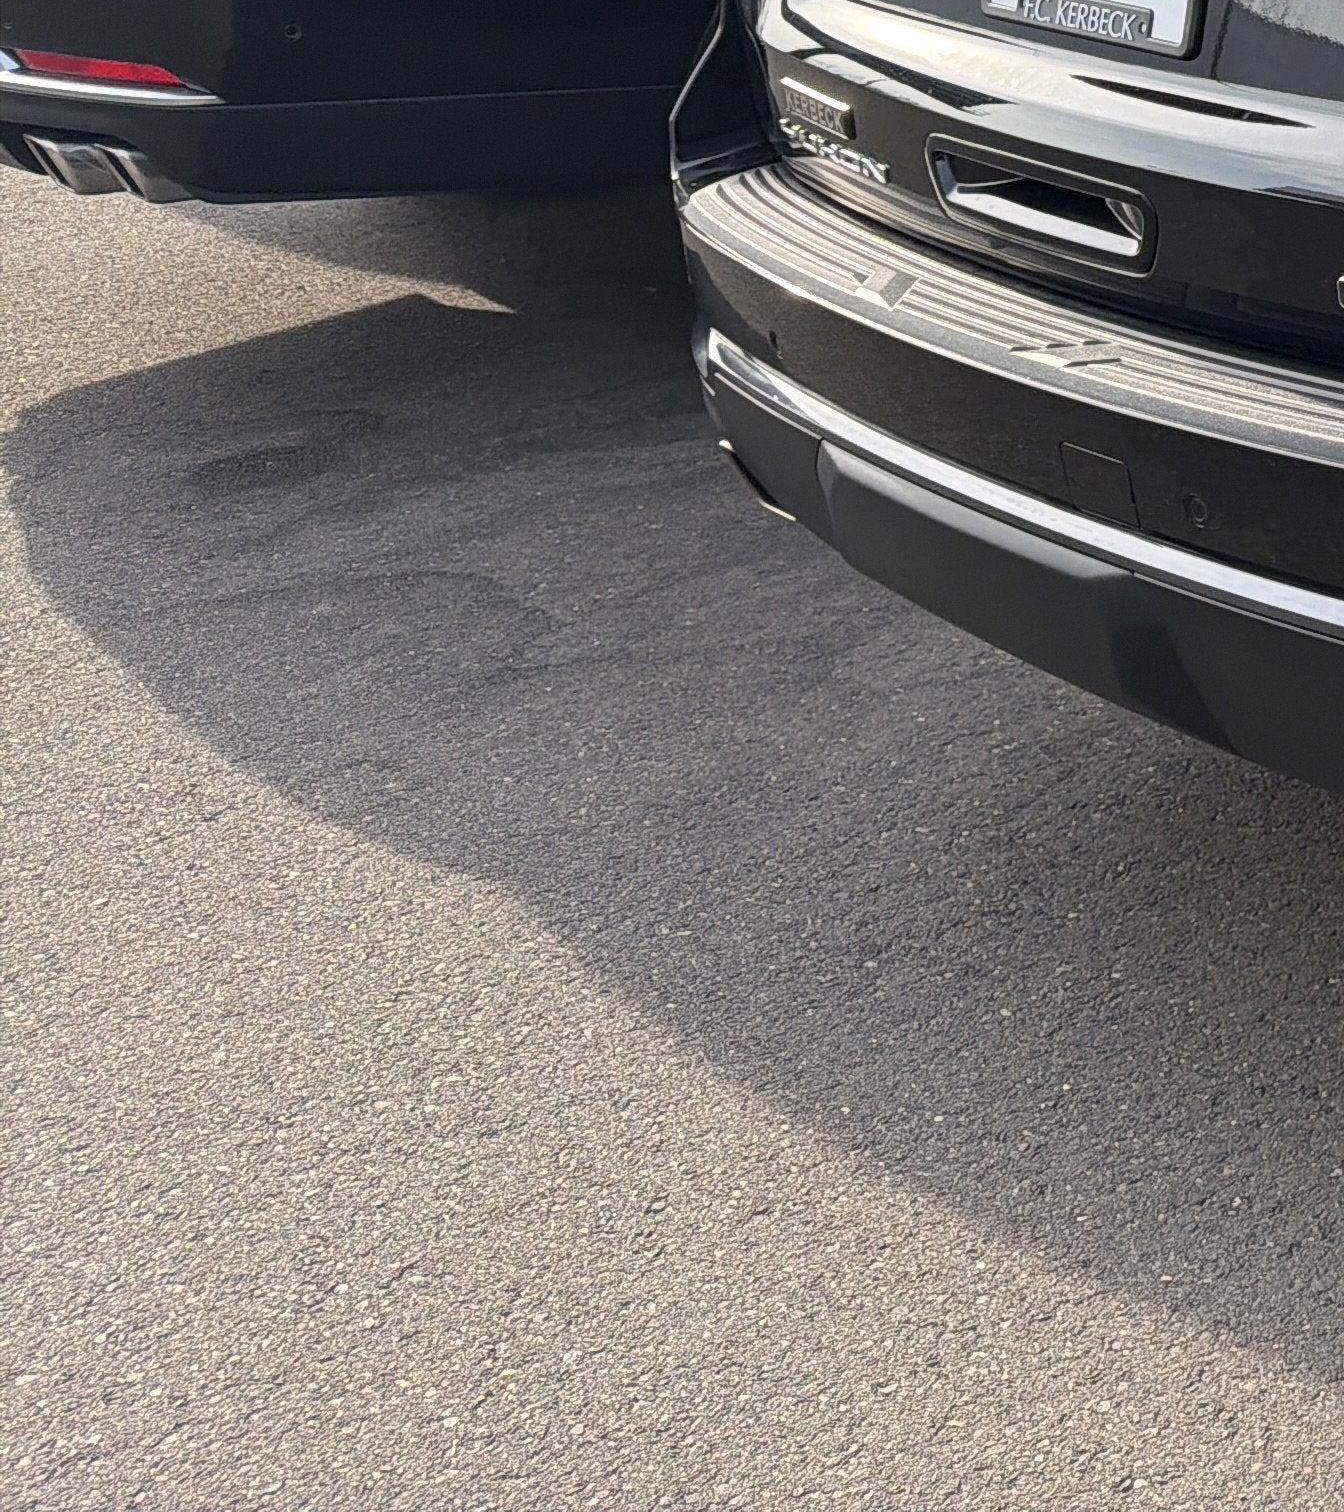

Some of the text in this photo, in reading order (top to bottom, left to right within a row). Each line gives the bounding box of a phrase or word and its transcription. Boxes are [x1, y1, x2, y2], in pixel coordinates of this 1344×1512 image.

[1055, 0, 1137, 40] KERBECK
[784, 88, 845, 134] KERBECK
[779, 118, 890, 184] YUKON
